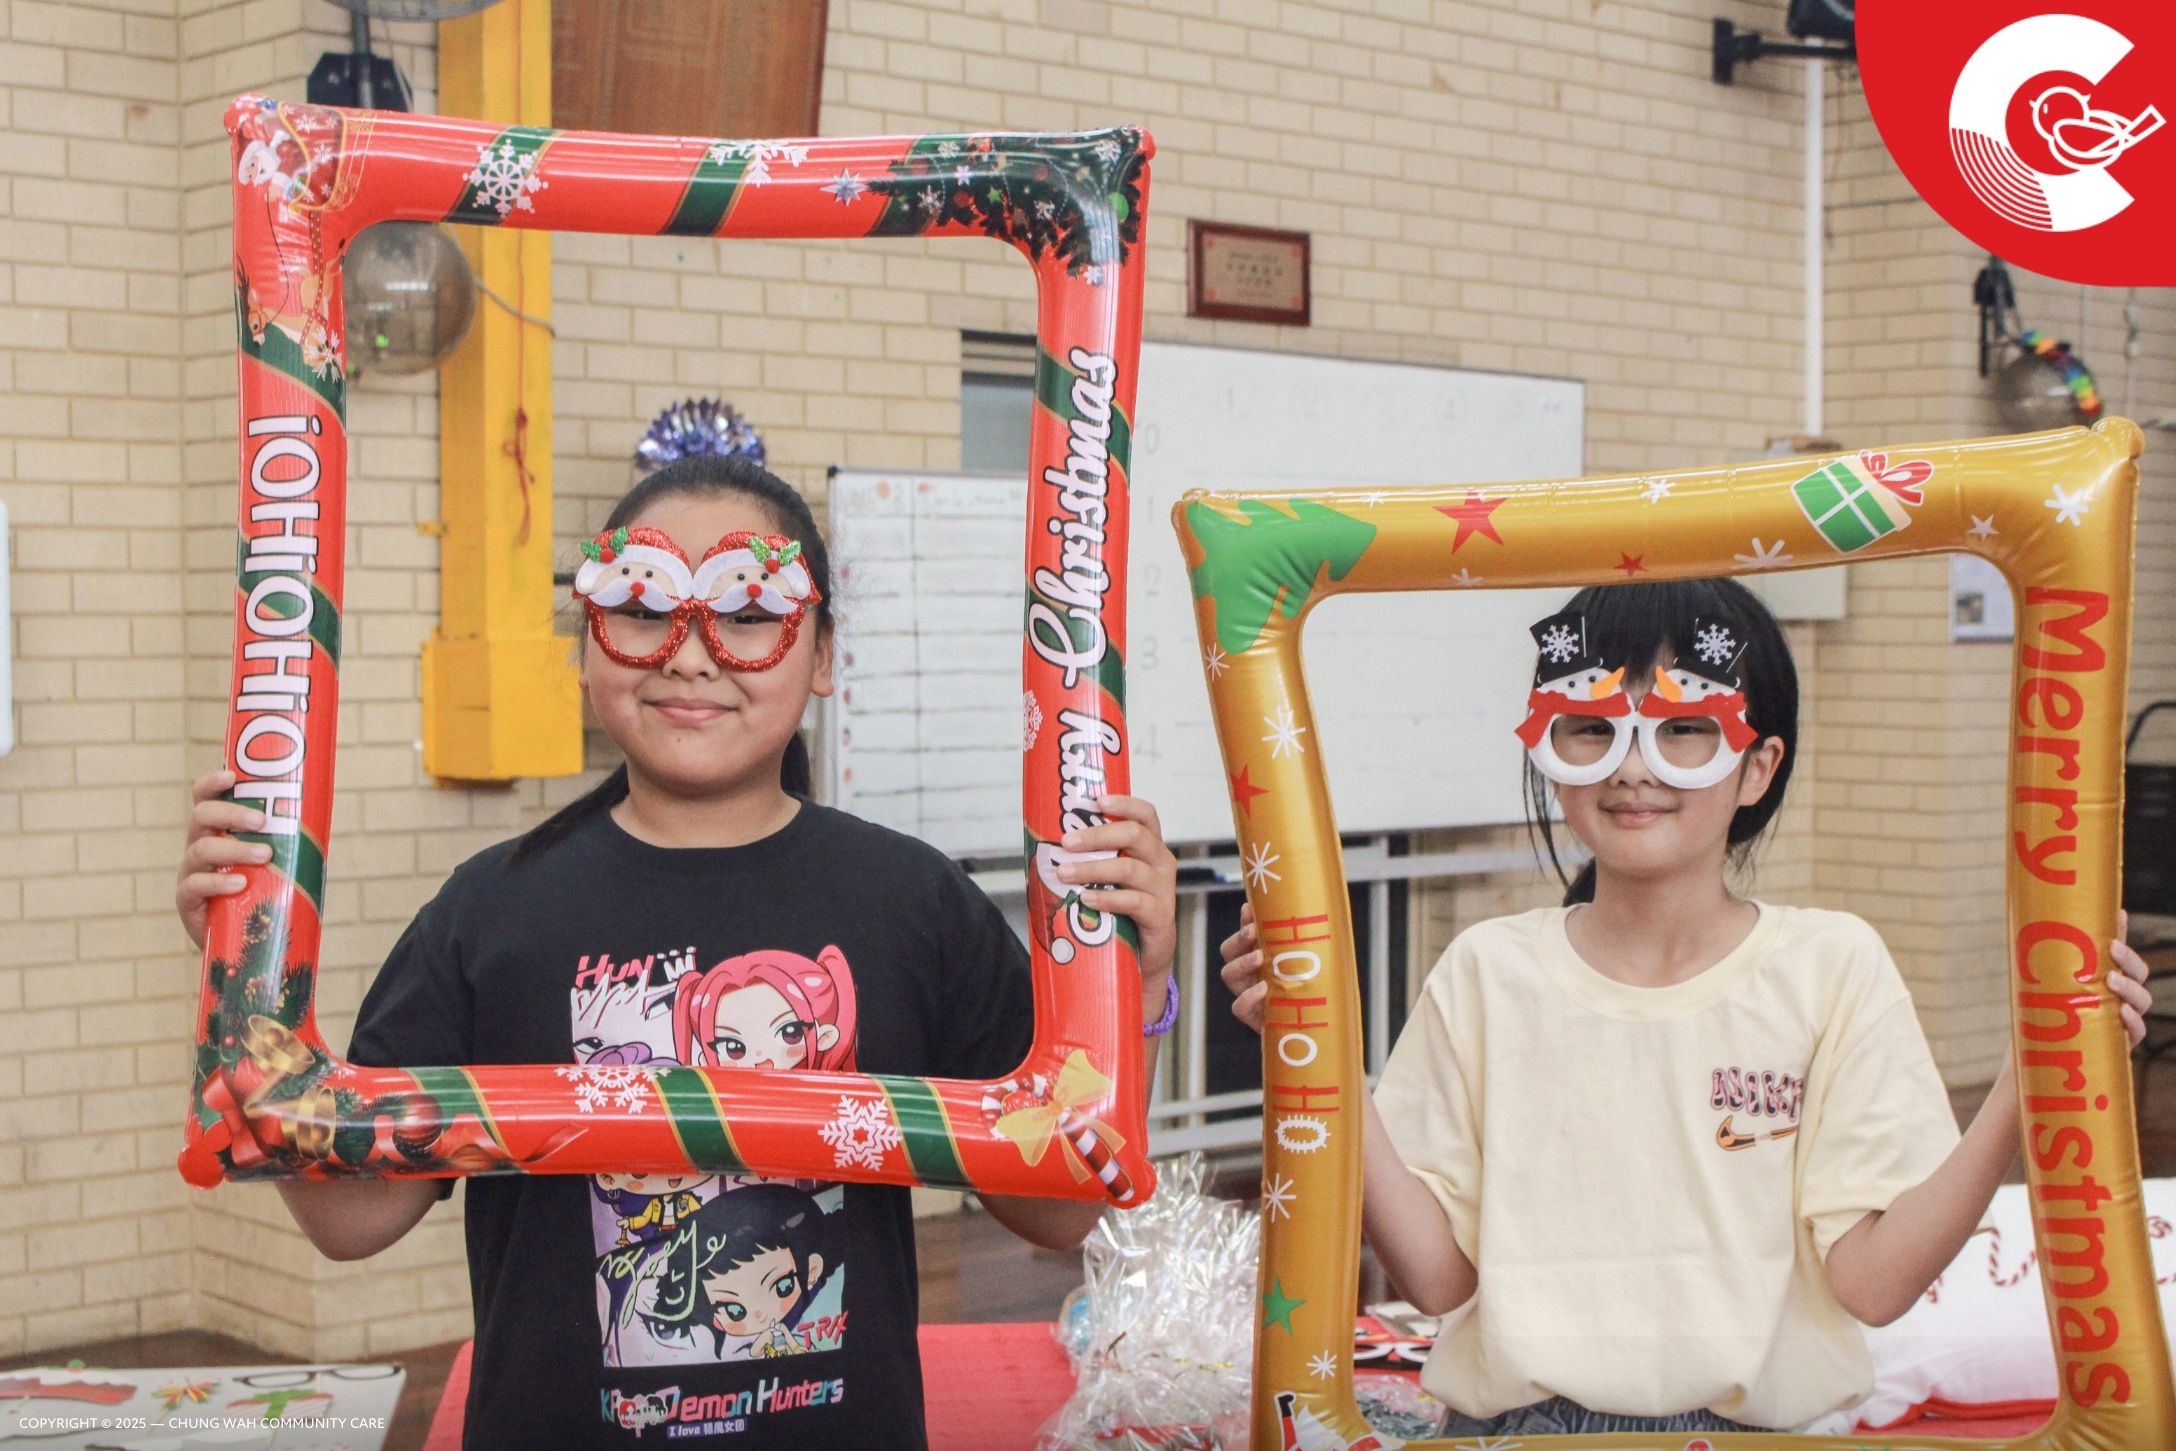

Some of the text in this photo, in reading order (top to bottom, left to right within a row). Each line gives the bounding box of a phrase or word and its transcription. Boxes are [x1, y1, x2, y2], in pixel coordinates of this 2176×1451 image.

[1026, 346, 1119, 690] Christmas
[2013, 585, 2131, 1409] Merry Christmas
[654, 1385, 753, 1422] Demon
[755, 1376, 844, 1414] Hunters
[677, 1424, 701, 1438] love
